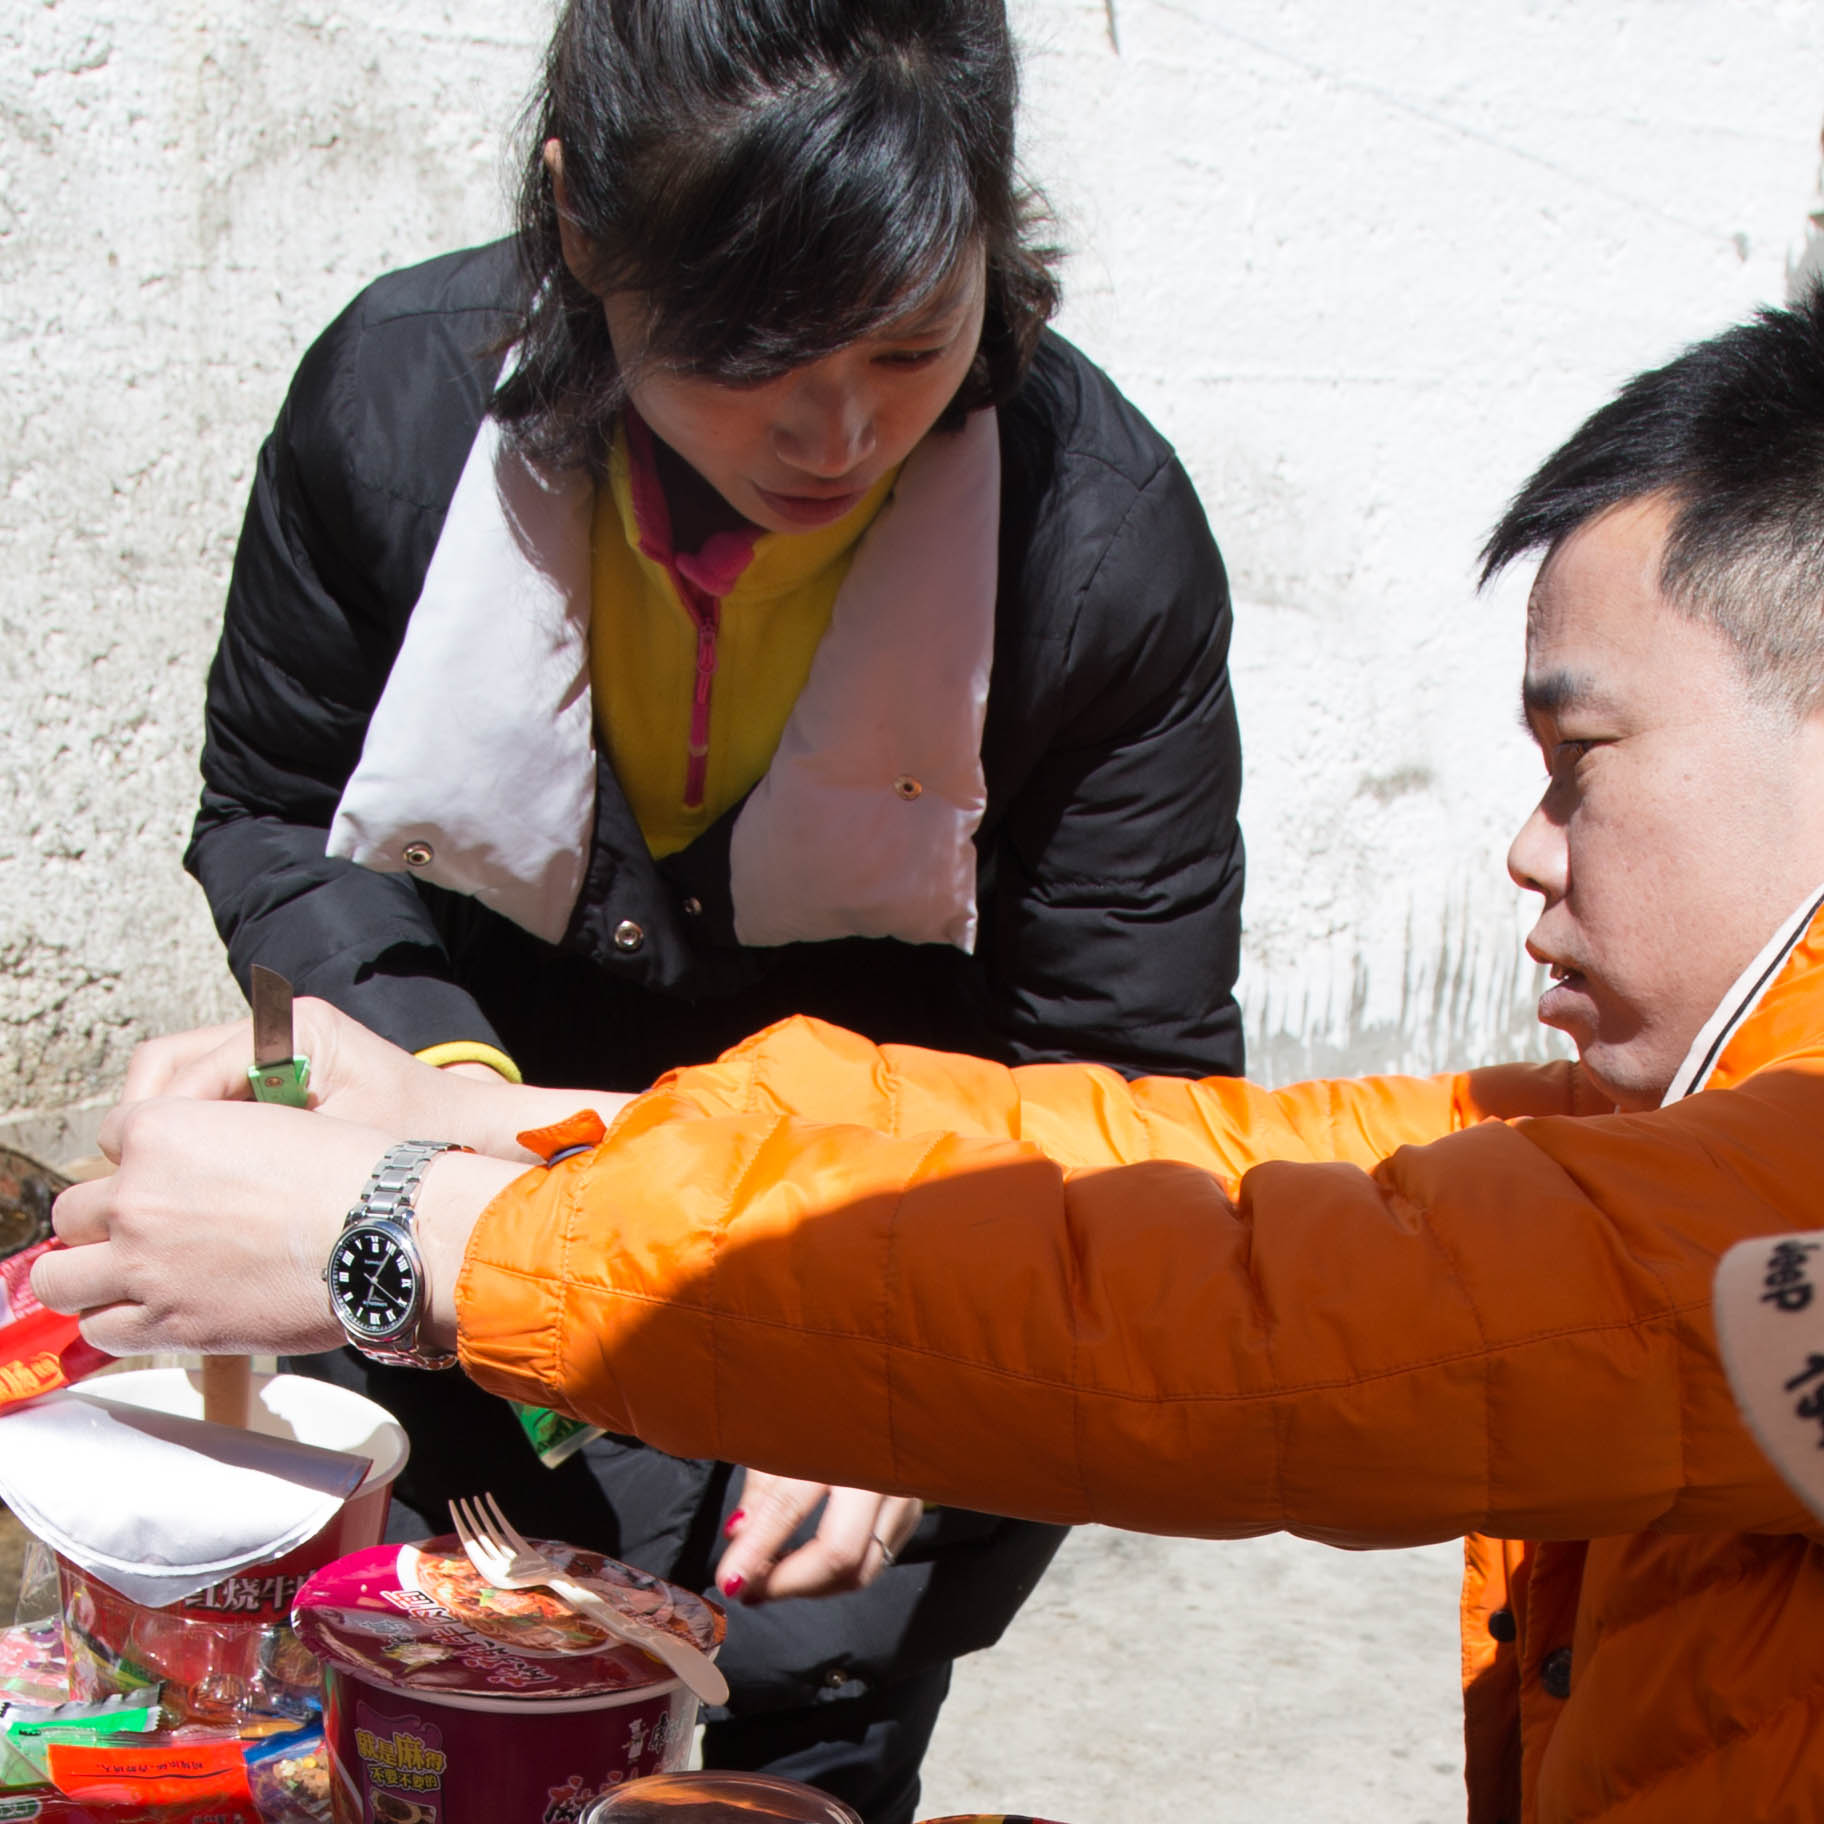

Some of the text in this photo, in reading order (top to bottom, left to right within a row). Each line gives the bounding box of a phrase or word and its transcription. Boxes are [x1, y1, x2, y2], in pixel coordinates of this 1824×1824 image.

[184, 1569, 317, 1612] 红烧牛
[354, 1728, 447, 1775] 就是麻得
[368, 1765, 440, 1792] 不要不要的
